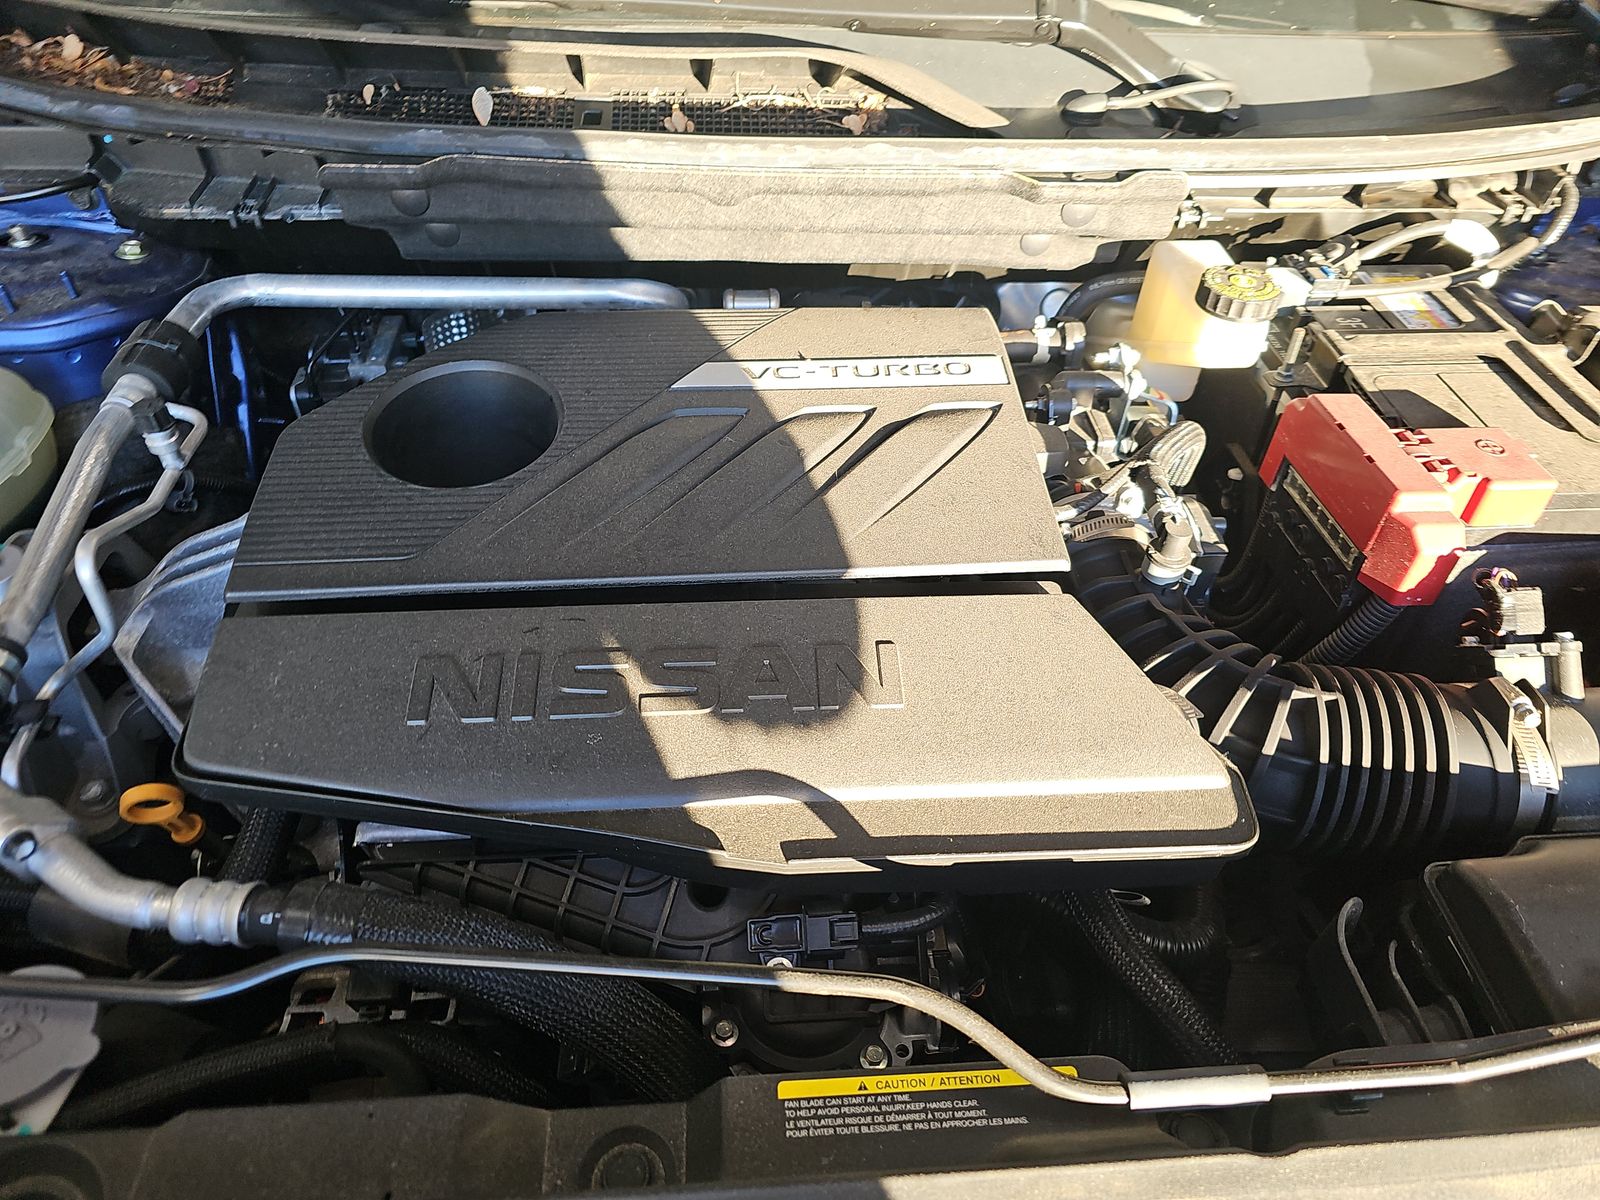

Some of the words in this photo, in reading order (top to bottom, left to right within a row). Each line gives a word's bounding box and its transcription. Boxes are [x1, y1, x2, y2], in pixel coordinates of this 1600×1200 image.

[741, 361, 972, 379] VC-TURBO
[405, 639, 905, 726] NISSAN
[876, 1078, 926, 1090] CAUTION
[940, 1074, 1000, 1086] ATTENTION
[784, 1100, 799, 1108] FAN
[801, 1099, 824, 1108] BLADE
[826, 1098, 842, 1106] CAN
[843, 1096, 866, 1105] START
[785, 1110, 796, 1118] TO
[797, 1108, 816, 1117] HELP
[818, 1108, 840, 1116] AVOID
[841, 1105, 880, 1114] PERSONAL
[926, 1100, 952, 1109] HANDS
[954, 1100, 979, 1108] CLEAR.
[786, 1120, 795, 1128] LE
[796, 1118, 844, 1128] VENTILATEUR
[845, 1116, 873, 1124] RISQUE
[874, 1115, 884, 1123] DE
[886, 1112, 926, 1122] DÉMARRER
[927, 1110, 934, 1119] À
[934, 1110, 954, 1118] TOUT
[954, 1109, 988, 1118] MOMENT.
[786, 1130, 808, 1138] POUR
[809, 1127, 834, 1137] ÉVITER
[836, 1126, 860, 1134] TOUTE
[902, 1122, 914, 1131] NE
[914, 1122, 930, 1130] PAS
[930, 1121, 941, 1129] EN
[942, 1119, 988, 1128] APPROCHER
[989, 1118, 1002, 1126] LES
[1004, 1116, 1029, 1125] MAINS.
